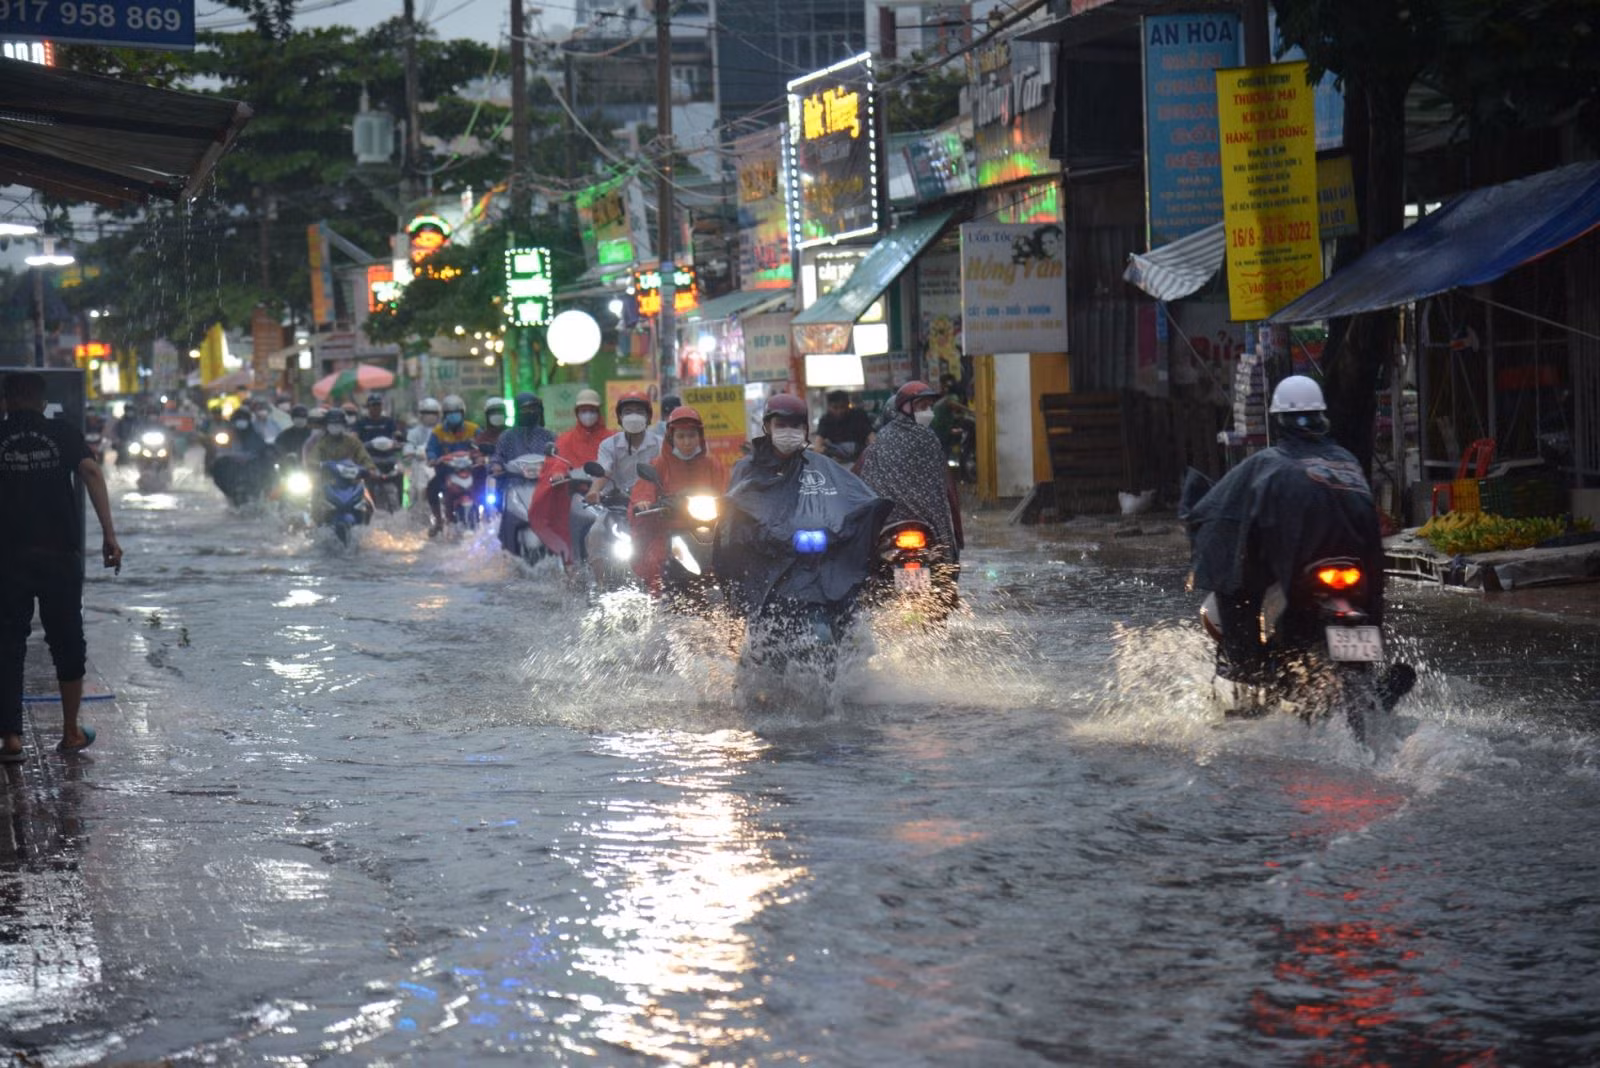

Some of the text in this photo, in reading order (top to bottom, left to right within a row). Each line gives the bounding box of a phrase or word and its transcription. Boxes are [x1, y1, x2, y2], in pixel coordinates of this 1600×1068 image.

[60, 2, 116, 27] 958
[127, 6, 181, 31] 869
[1151, 24, 1179, 45] AN
